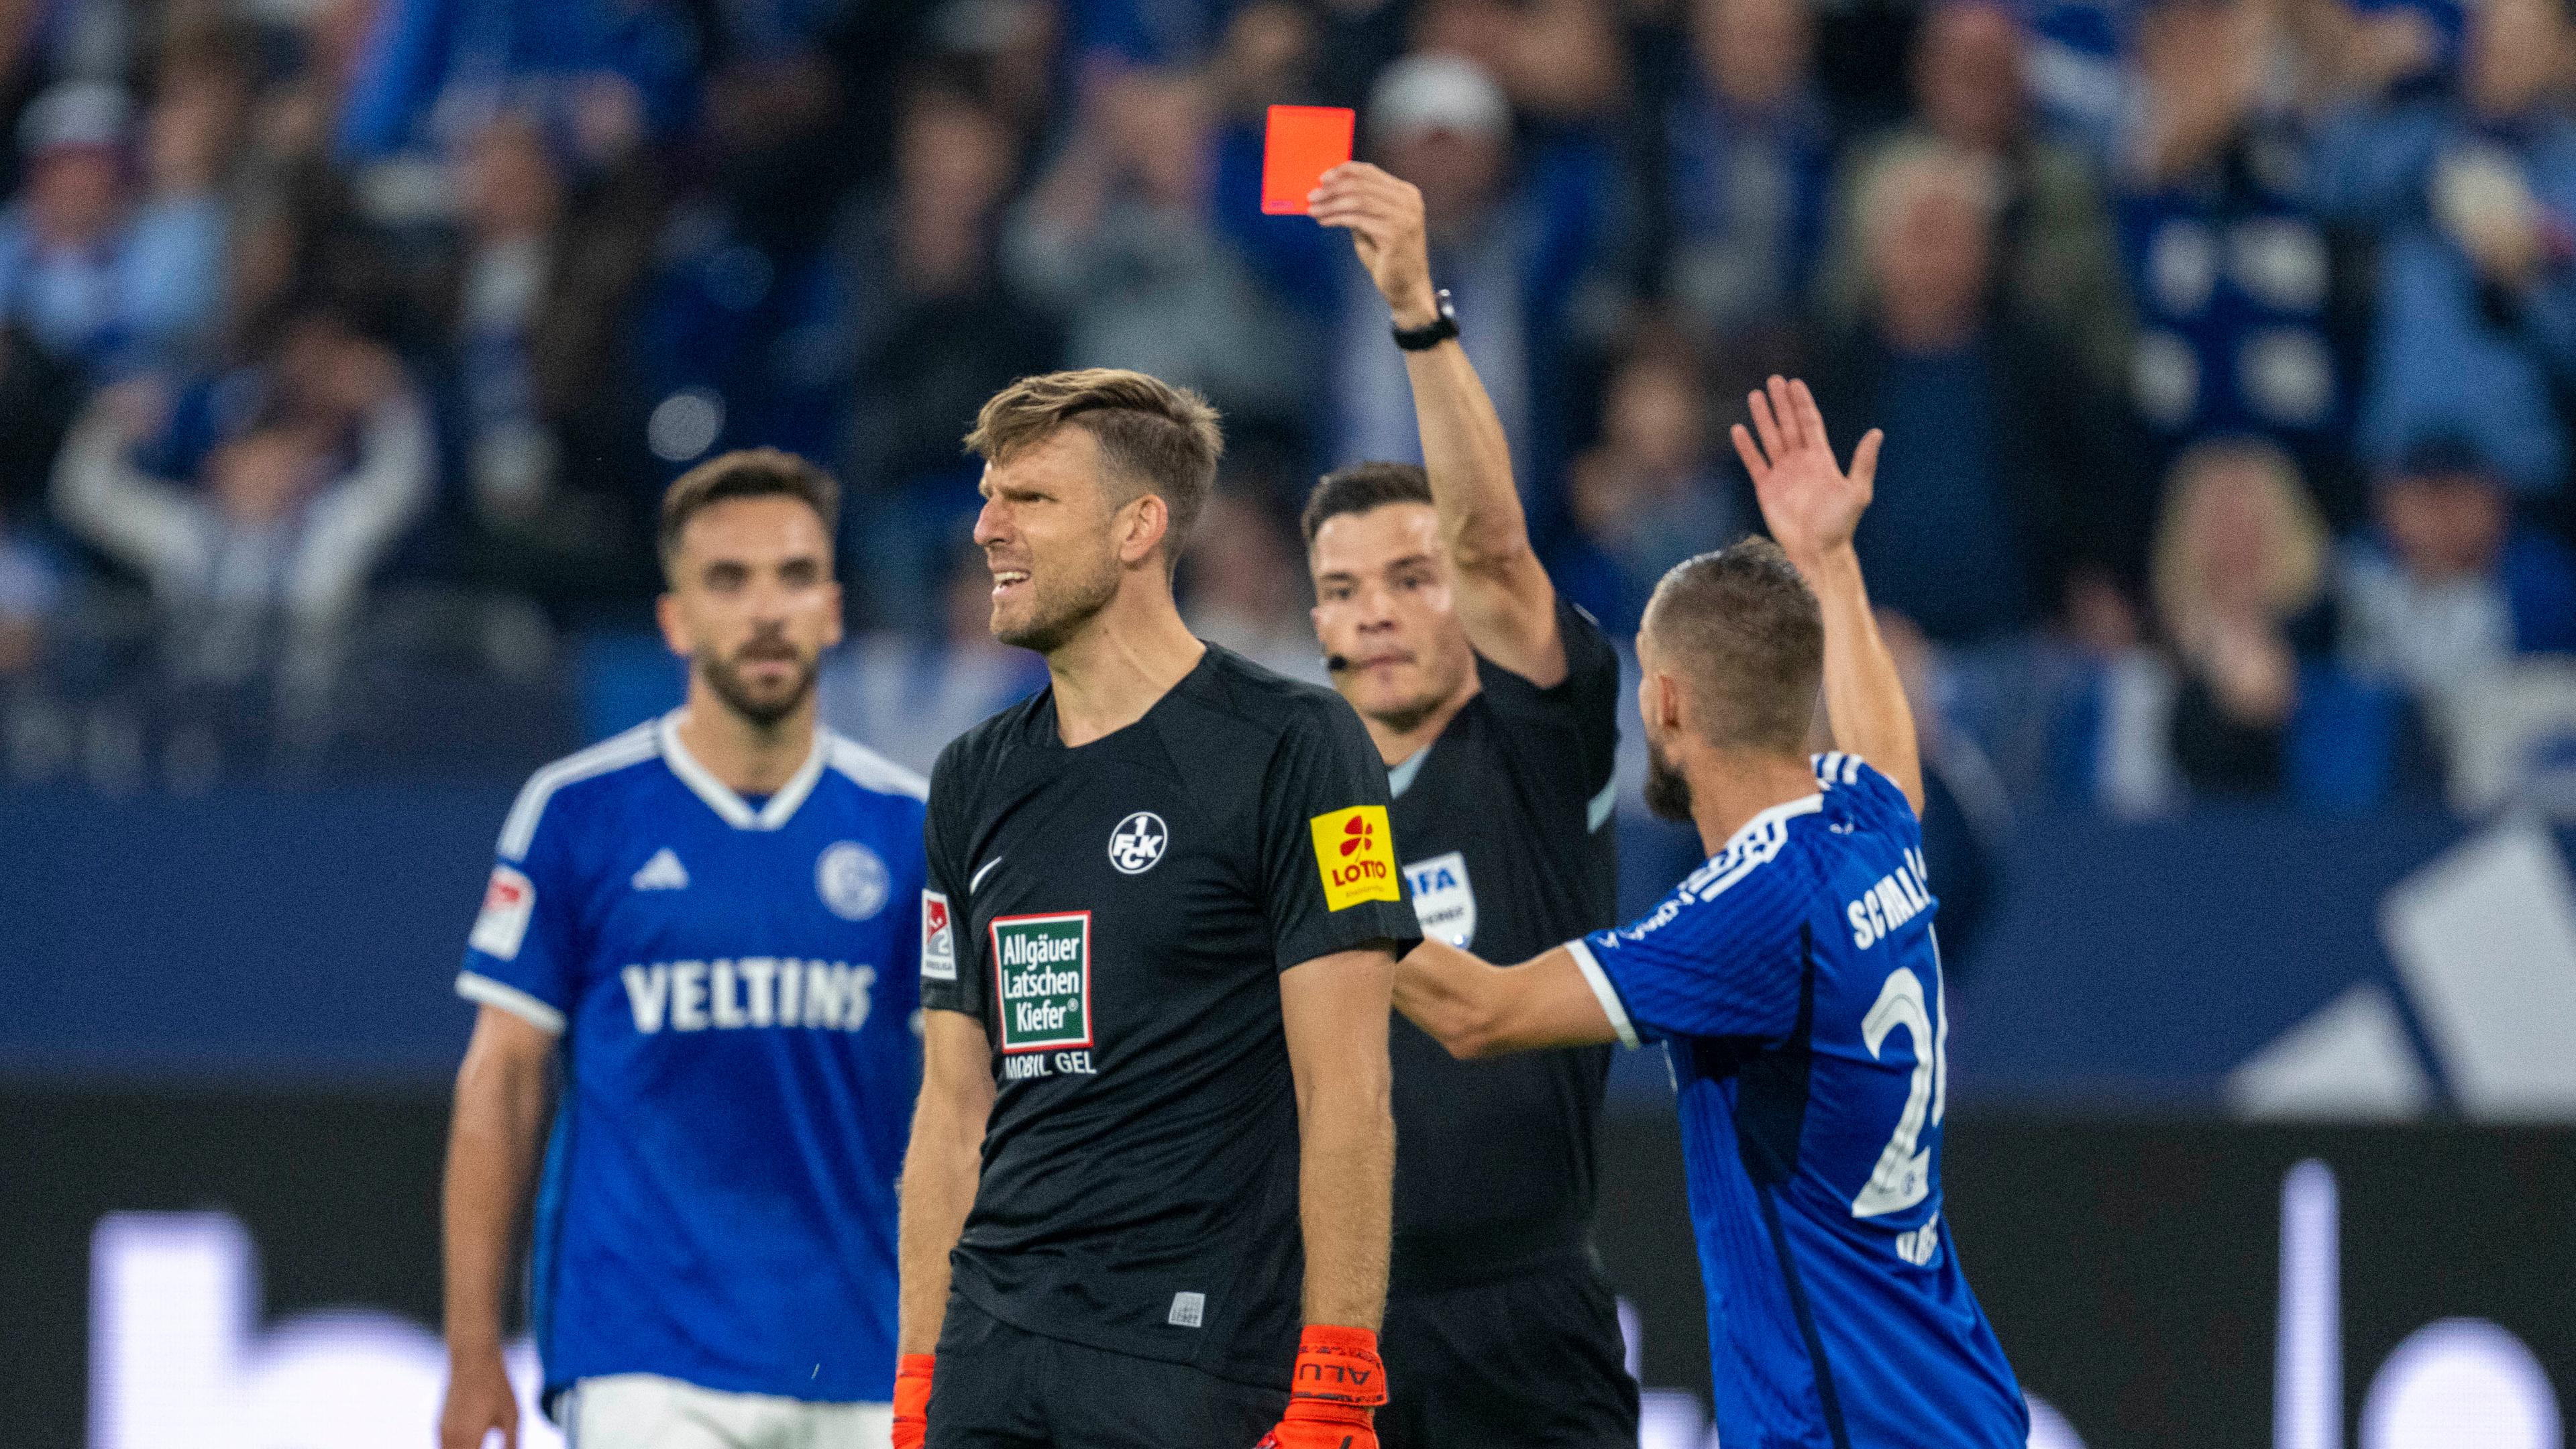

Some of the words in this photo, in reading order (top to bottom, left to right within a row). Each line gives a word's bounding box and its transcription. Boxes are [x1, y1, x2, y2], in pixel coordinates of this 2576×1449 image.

[1332, 860, 1387, 887] LOTTO
[1004, 933, 1079, 971] Allgäuer
[621, 957, 877, 1034] VELTINS
[1004, 965, 1079, 999] Latschen
[1006, 1055, 1053, 1079] MOBIL
[1055, 1051, 1097, 1074] GEL
